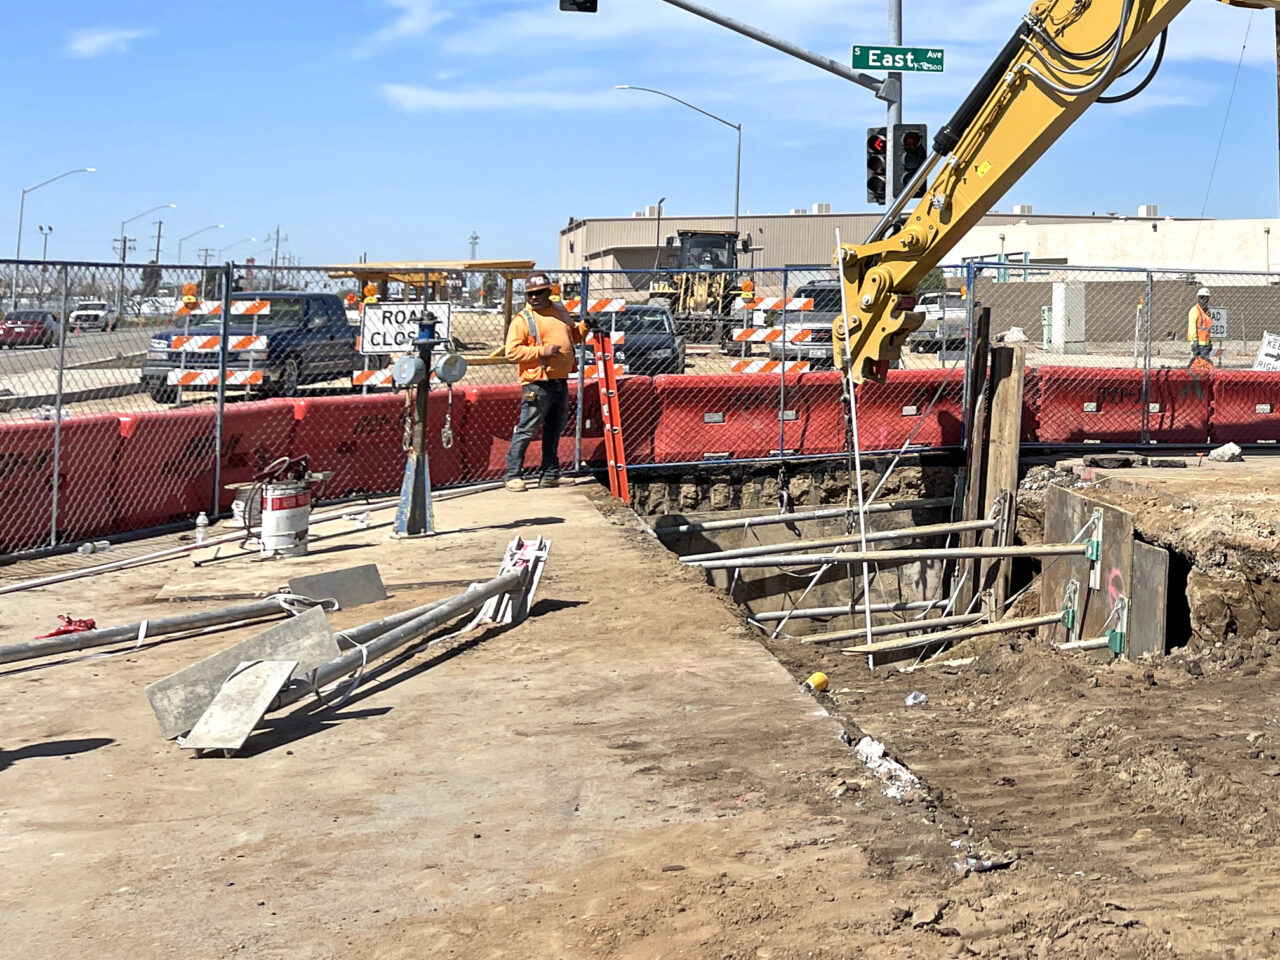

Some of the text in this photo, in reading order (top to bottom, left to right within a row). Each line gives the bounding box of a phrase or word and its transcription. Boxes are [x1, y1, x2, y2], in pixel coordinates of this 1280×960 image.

[854, 47, 942, 67] S East Ave
[382, 310, 427, 326] ROA
